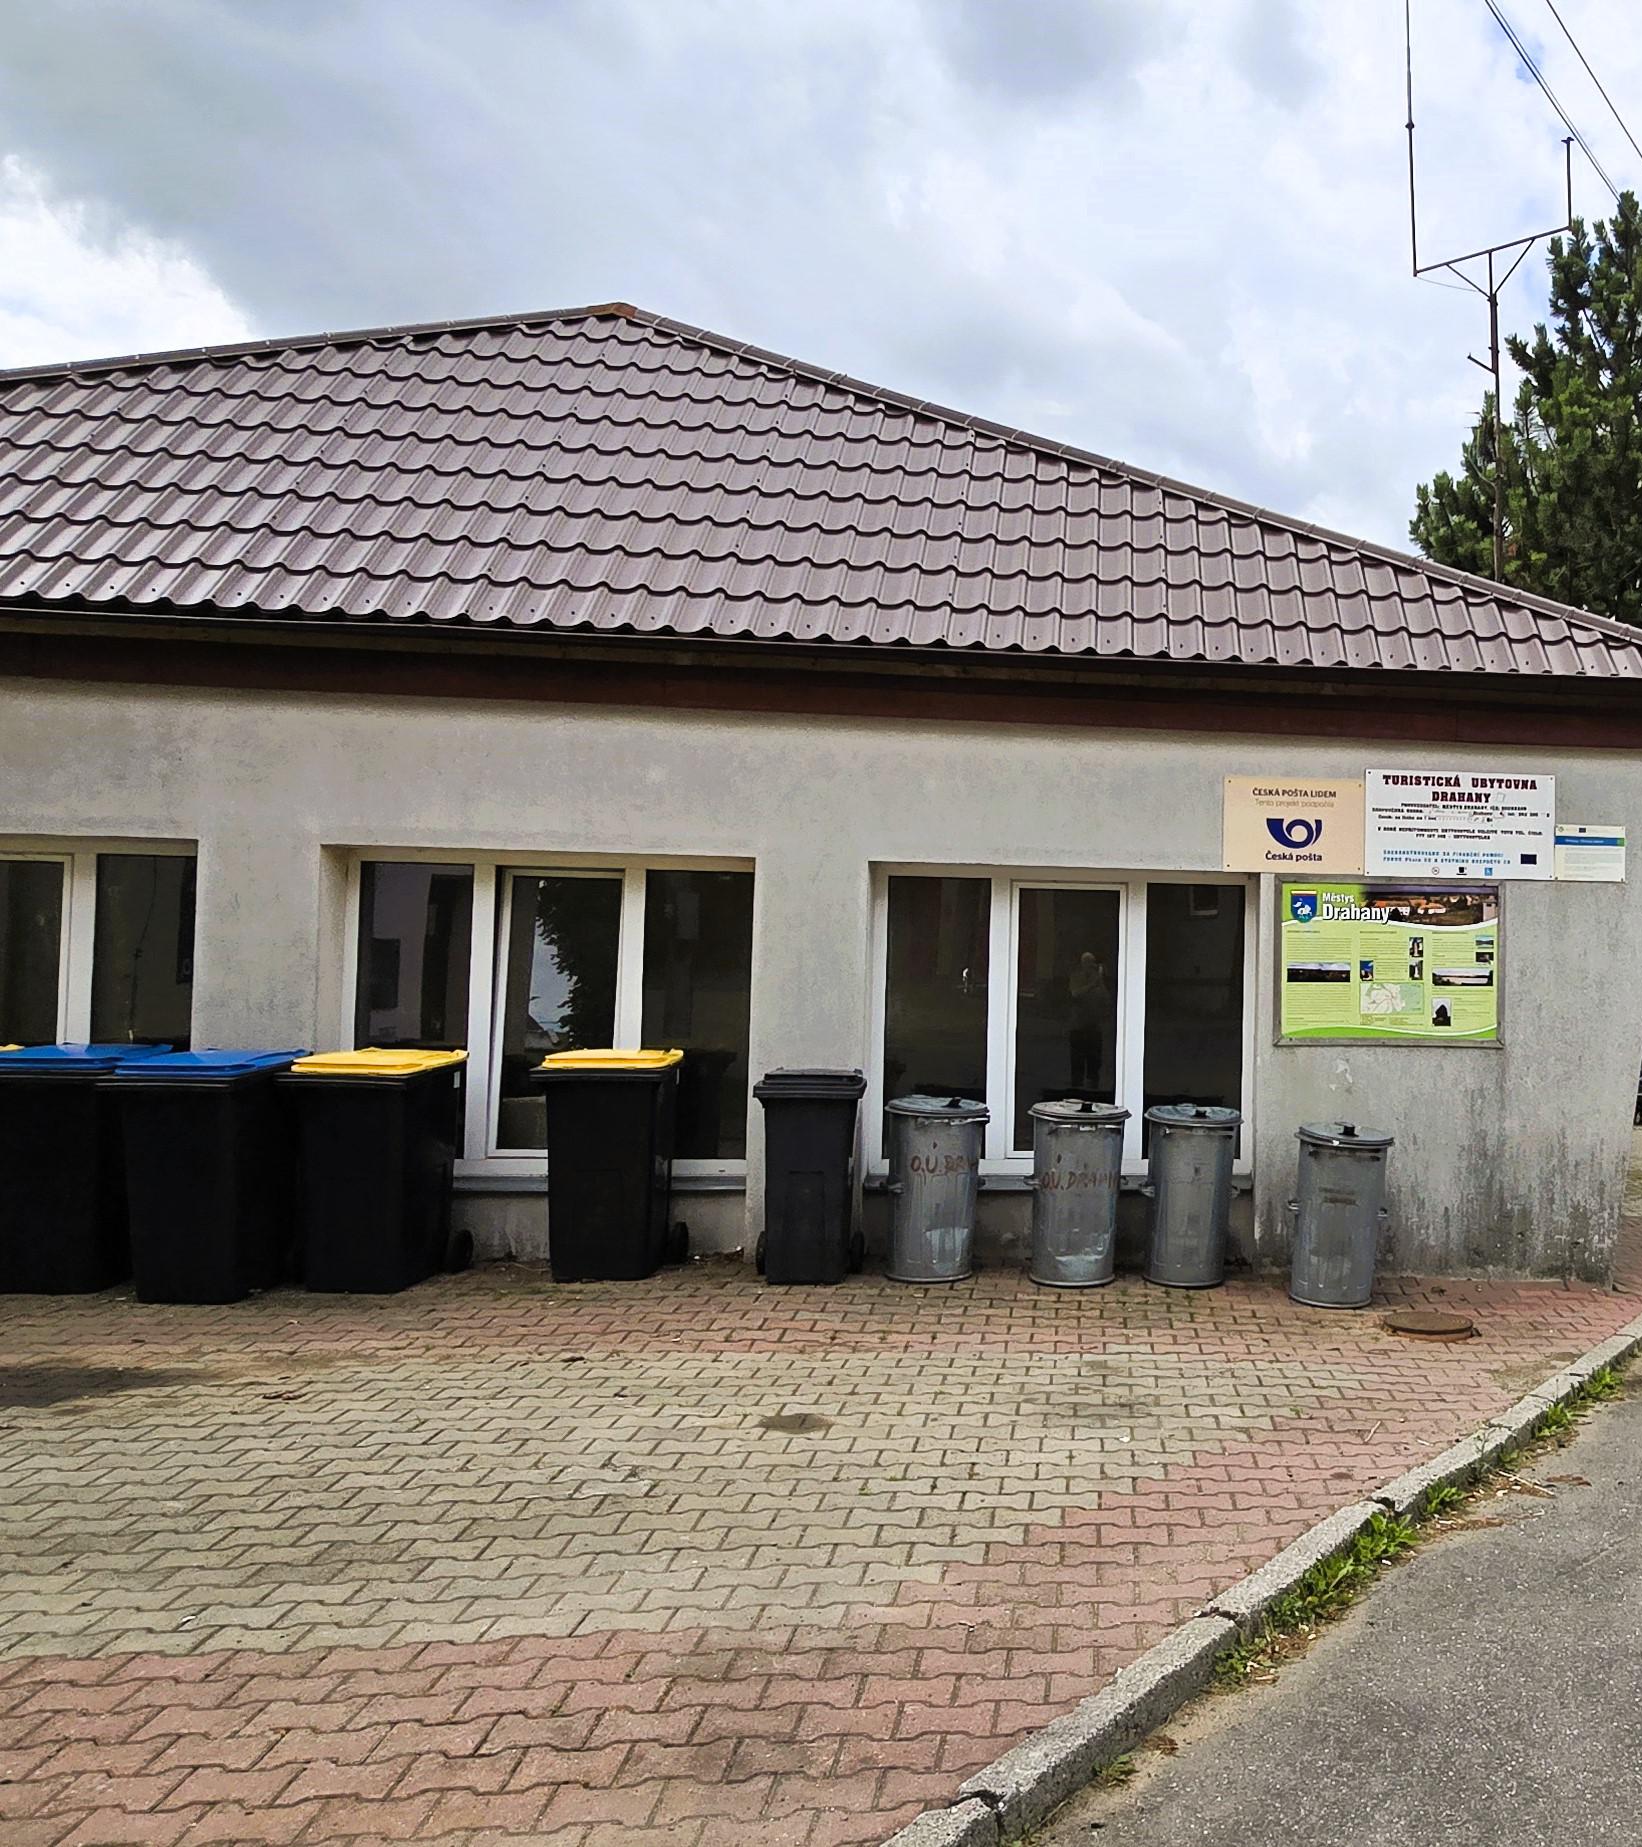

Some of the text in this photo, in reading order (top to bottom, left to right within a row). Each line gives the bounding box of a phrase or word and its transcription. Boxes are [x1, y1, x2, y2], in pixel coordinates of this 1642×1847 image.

[1382, 774, 1537, 790] TURISTICKÁ UBYTOVNA
[1252, 787, 1337, 799] ČESKÁ POŠTA LIDEM
[1432, 791, 1491, 803] DRAHANY
[1276, 800, 1301, 808] projekt
[1265, 850, 1323, 863] Česká pošta
[1322, 892, 1355, 904] Městys
[1322, 903, 1390, 924] Drahany
